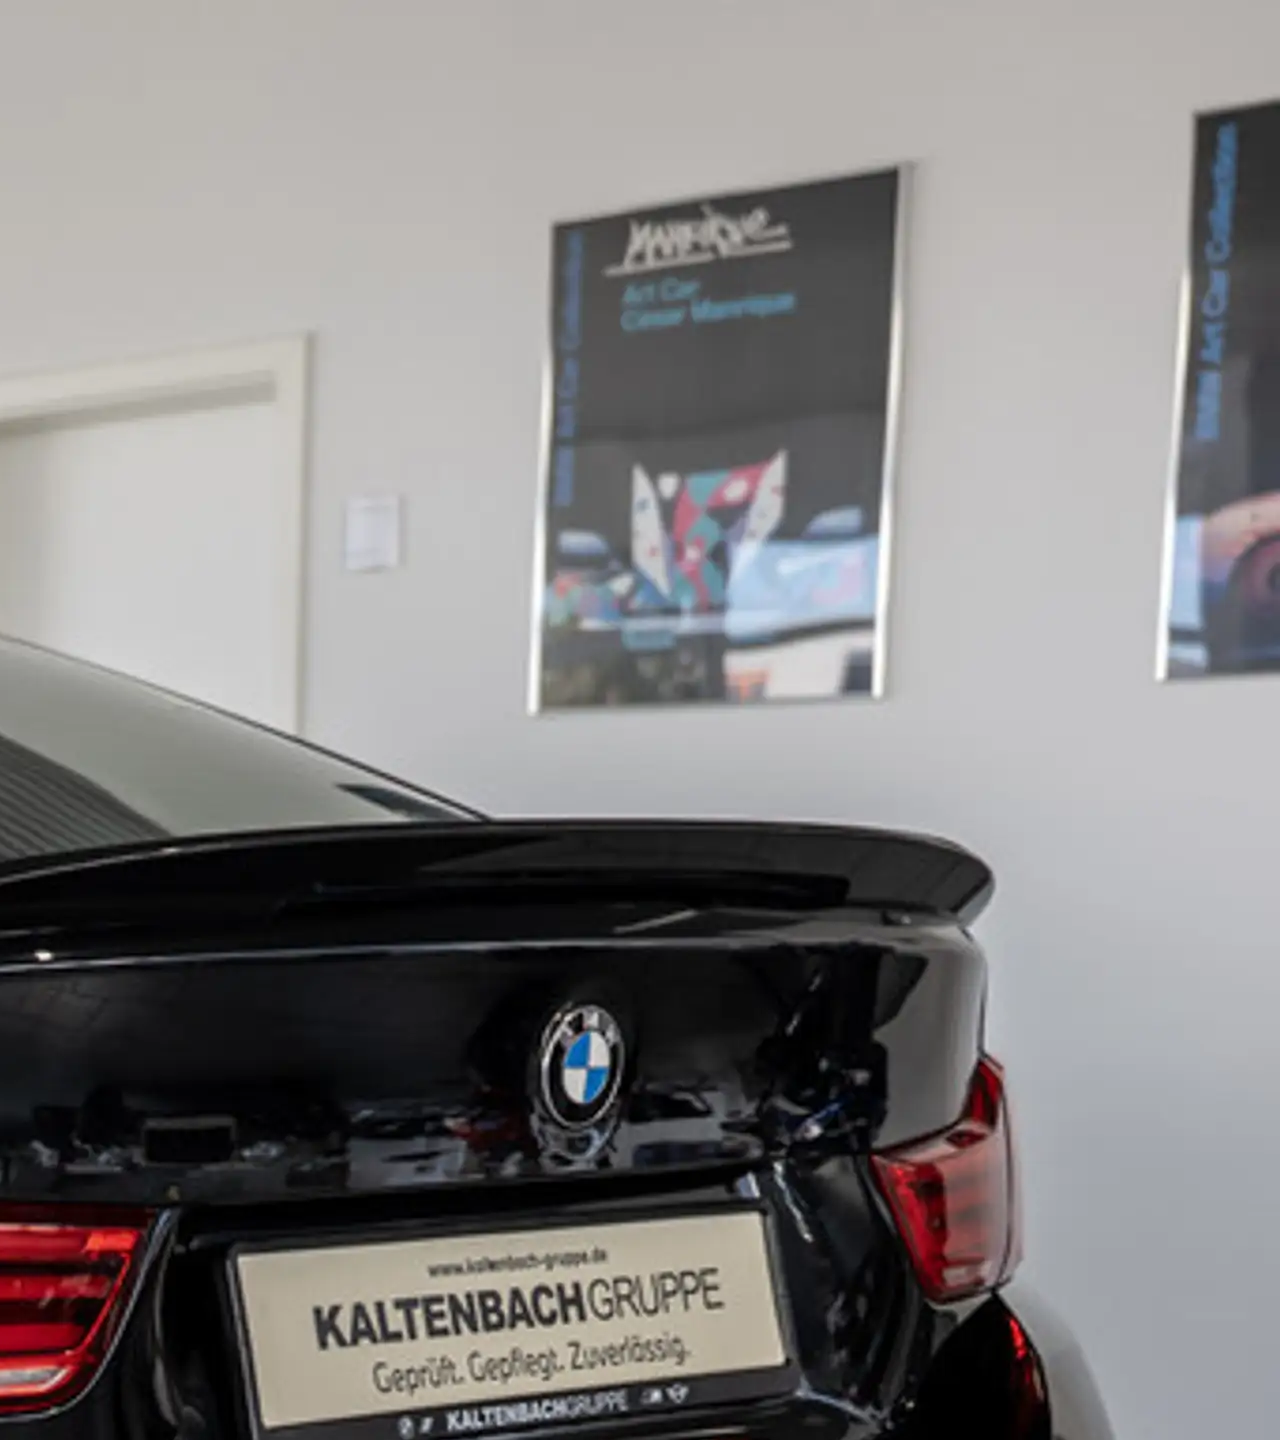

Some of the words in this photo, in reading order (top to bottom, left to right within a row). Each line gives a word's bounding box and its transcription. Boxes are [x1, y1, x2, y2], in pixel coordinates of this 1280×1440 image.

[427, 1247, 608, 1278] www.kaltenbach-gruppe.de
[313, 1267, 725, 1351] KALTENBACHGRUPPE
[372, 1358, 464, 1397] Geprüft.
[469, 1346, 566, 1383] Gepflegt.
[567, 1334, 693, 1372] Zuverlässig.
[445, 1389, 631, 1432] KALTENBACHGRUPPE
